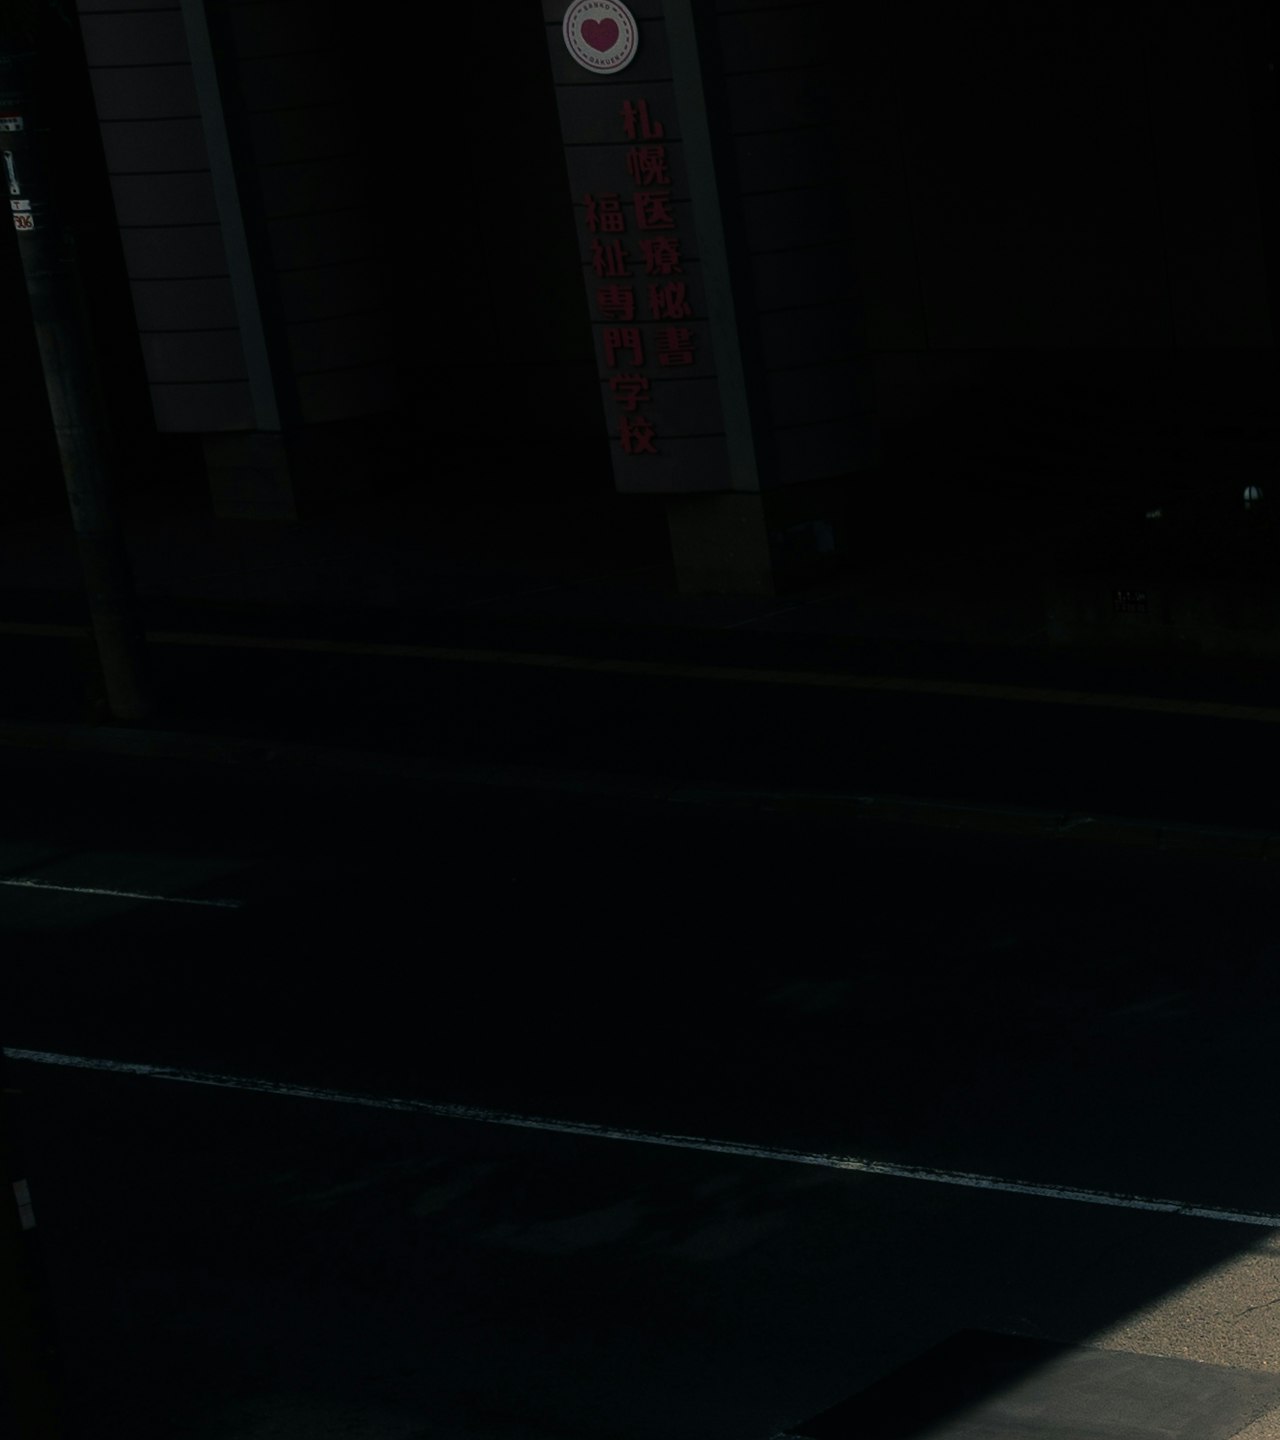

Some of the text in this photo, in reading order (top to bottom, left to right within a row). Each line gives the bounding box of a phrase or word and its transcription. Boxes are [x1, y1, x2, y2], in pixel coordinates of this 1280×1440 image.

[583, 2, 611, 11] SANKO
[589, 55, 622, 66] GAKUEN
[619, 97, 697, 368] 札幌医療秘書
[583, 191, 658, 455] 福祉専門学校
